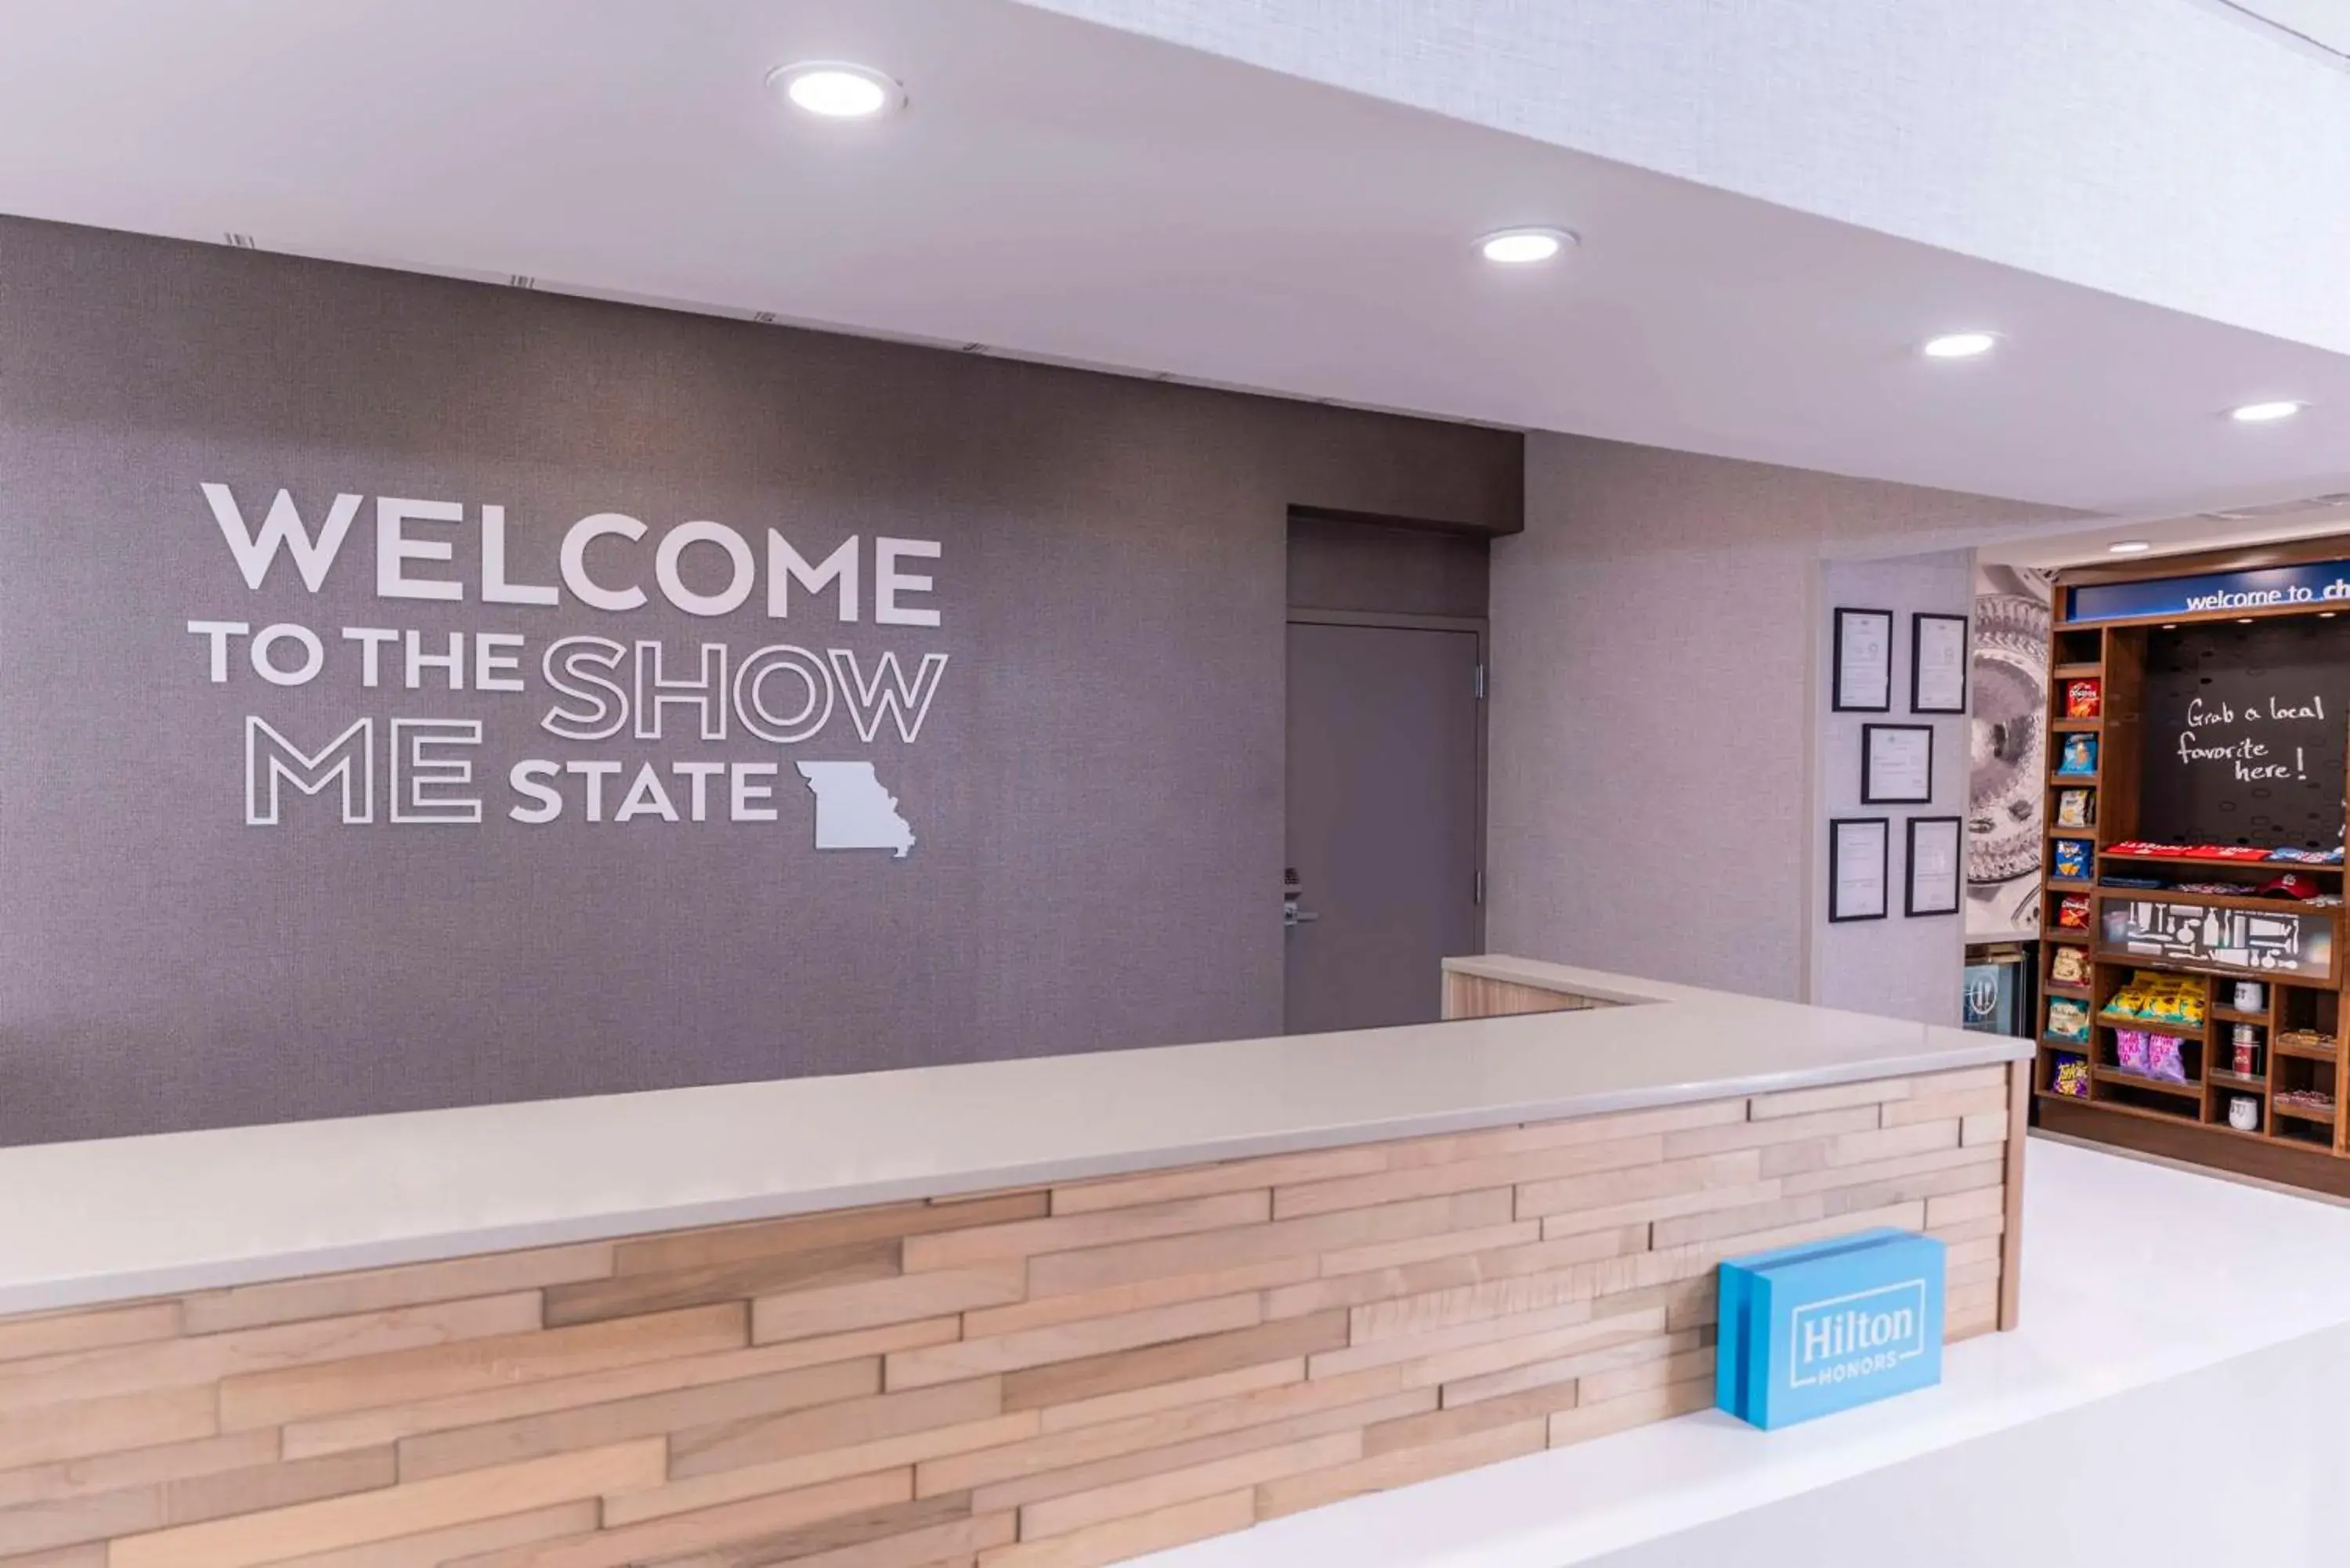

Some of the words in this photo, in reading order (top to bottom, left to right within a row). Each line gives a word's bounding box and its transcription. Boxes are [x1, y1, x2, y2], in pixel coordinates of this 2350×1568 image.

[200, 482, 942, 626] WELCOME
[2186, 590, 2282, 611] welcome
[2288, 585, 2312, 603] to
[187, 620, 324, 685] TO
[342, 627, 524, 691] THE
[540, 635, 949, 743] SHOW
[2188, 698, 2234, 728] Grab
[2244, 708, 2261, 721] a
[2270, 695, 2324, 720] local
[245, 715, 483, 825] ME
[509, 760, 778, 823] STATE
[2178, 731, 2269, 764] favorite
[1804, 1308, 1912, 1364] Hilton
[1818, 1350, 1896, 1385] HONORS
